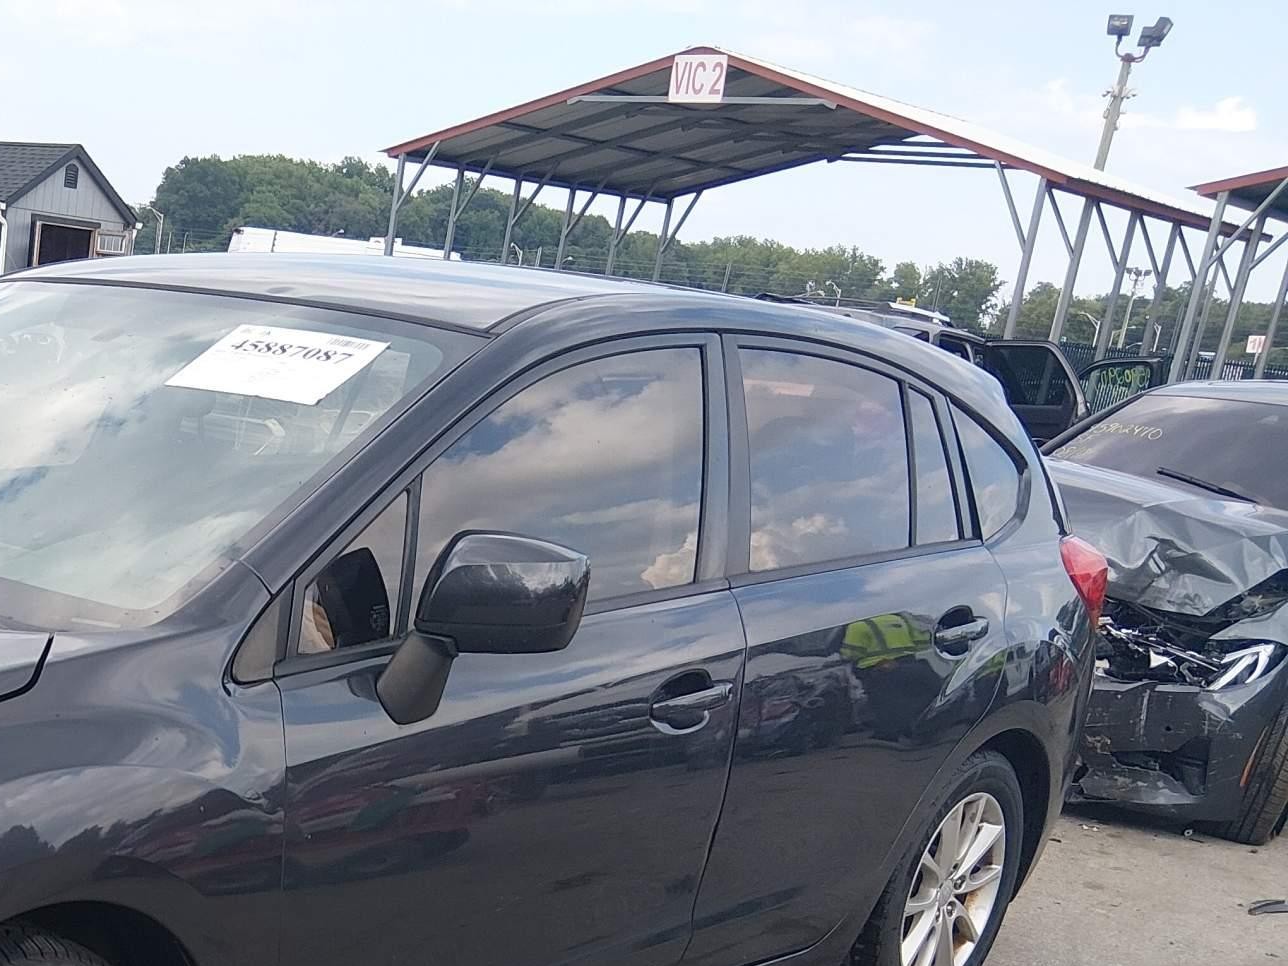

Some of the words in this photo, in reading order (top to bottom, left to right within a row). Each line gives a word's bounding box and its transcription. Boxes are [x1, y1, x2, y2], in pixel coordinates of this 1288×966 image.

[674, 61, 707, 96] VIC
[708, 61, 724, 96] 2
[231, 339, 355, 365] 45887087
